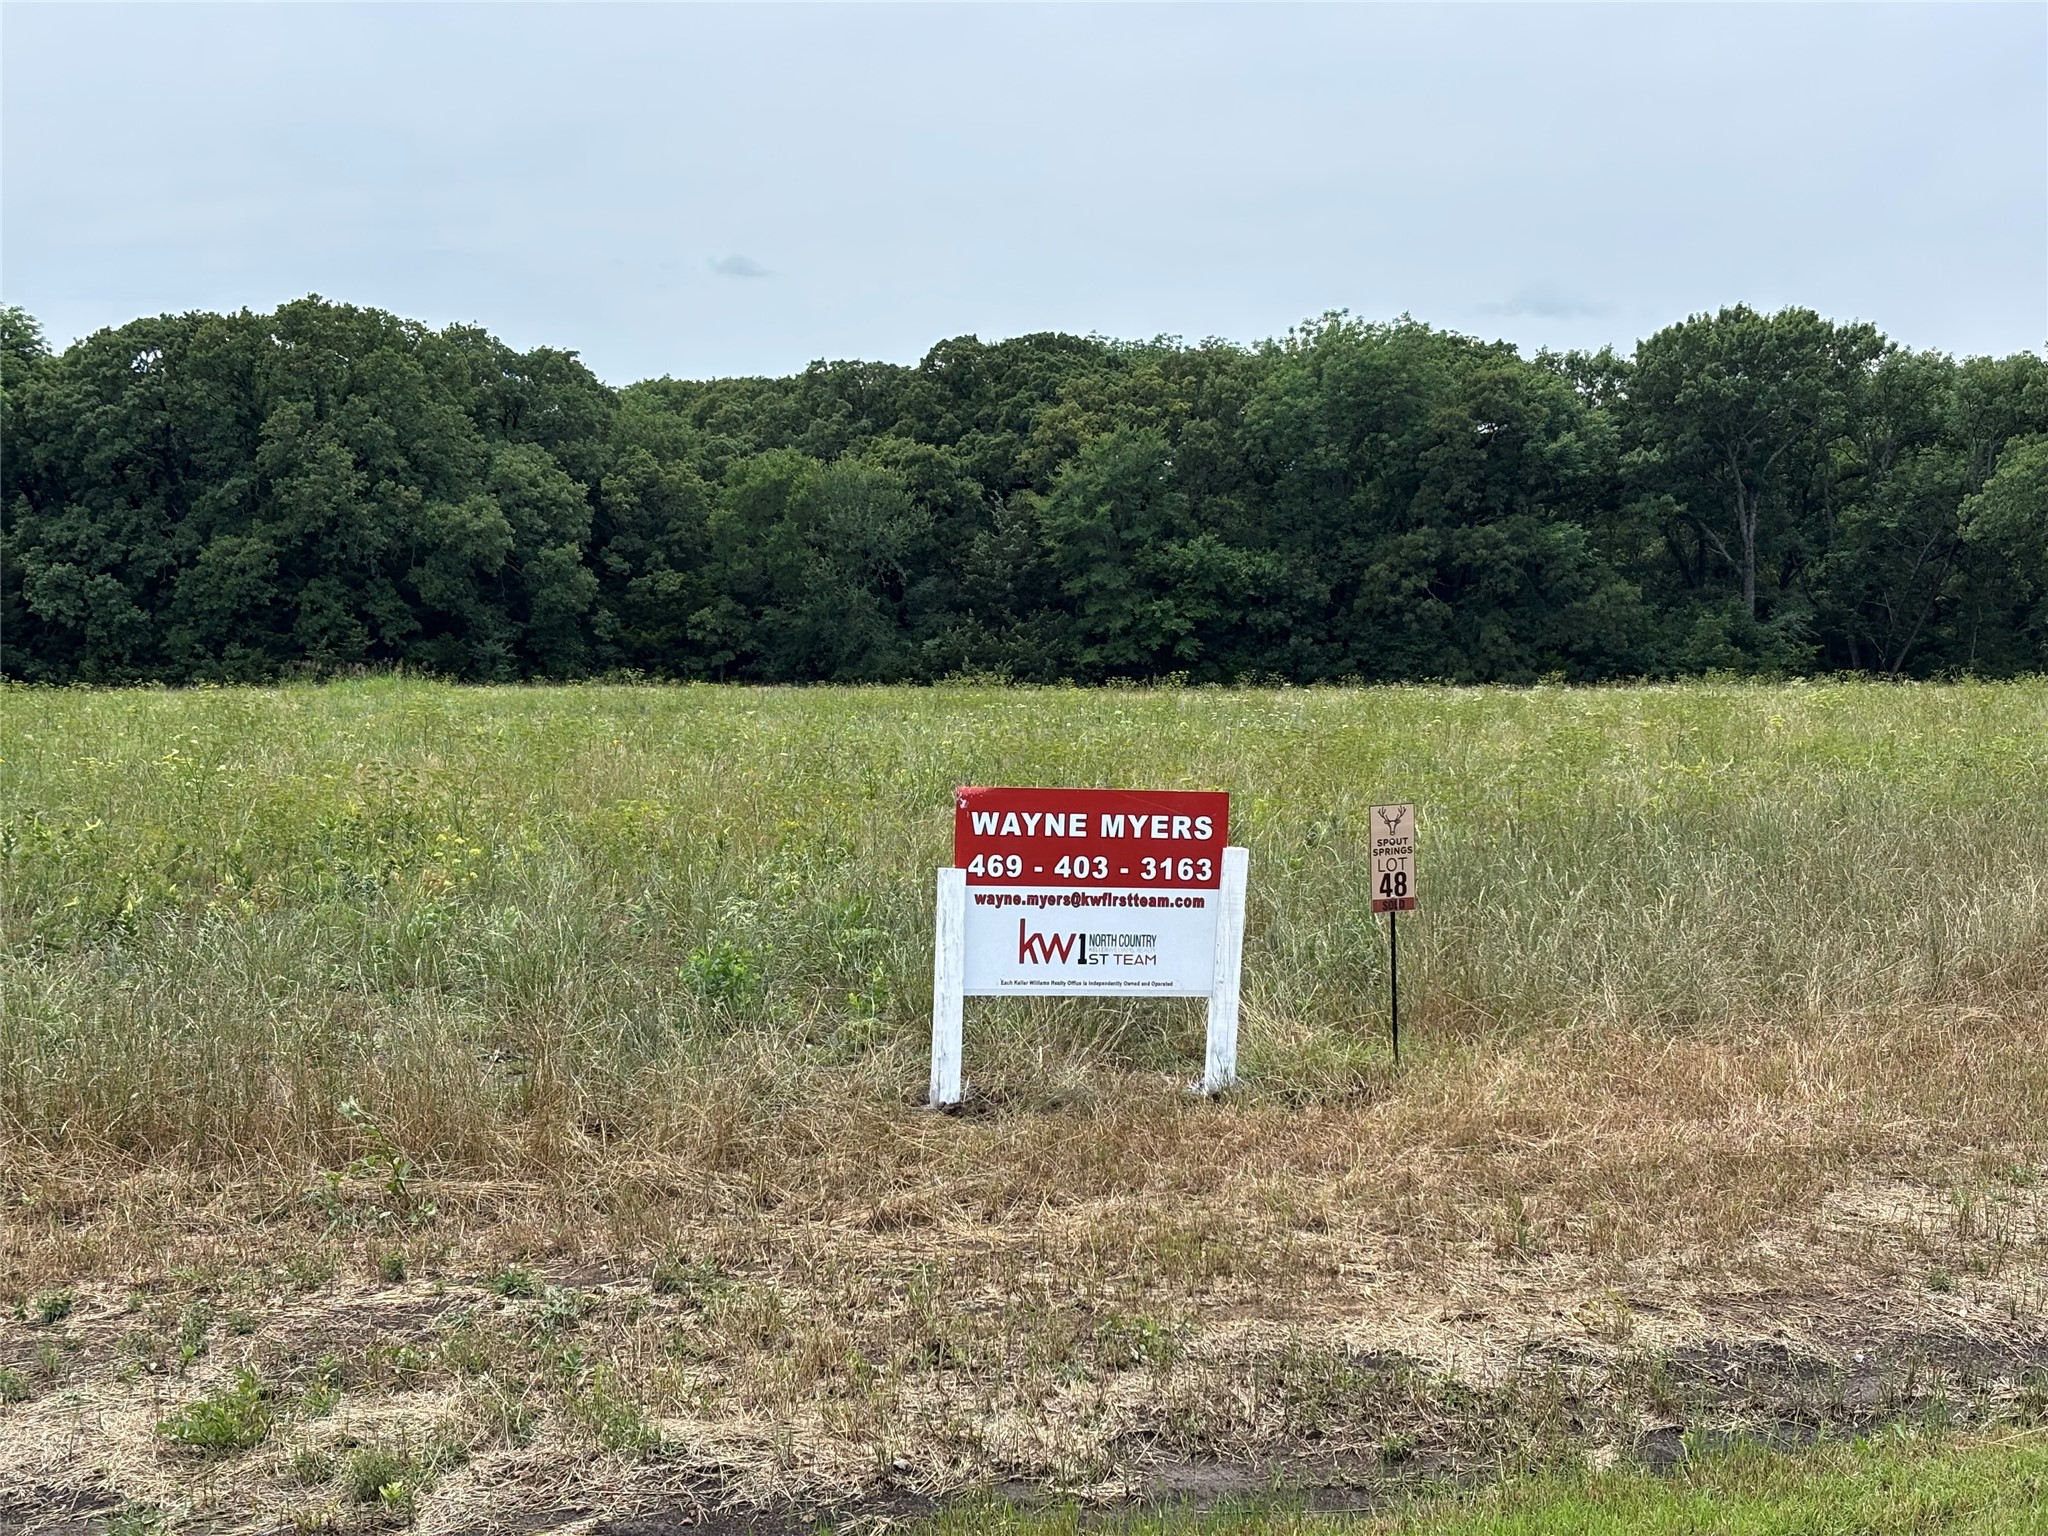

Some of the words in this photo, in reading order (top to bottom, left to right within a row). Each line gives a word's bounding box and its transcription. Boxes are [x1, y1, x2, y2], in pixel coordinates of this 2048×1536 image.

[971, 811, 1088, 838] WAYNE
[1100, 814, 1213, 840] MYERS
[1377, 837, 1408, 847] SPOUT
[1373, 846, 1413, 857] SPRINGS
[967, 854, 1023, 878] 469
[1054, 855, 1109, 880] 403
[1140, 857, 1213, 882] 3163
[1378, 857, 1408, 872] LOT
[1379, 872, 1407, 898] 48
[974, 892, 1205, 910] wayne.myers@kwfirstteam.com
[1382, 898, 1405, 911] SOLD
[1089, 933, 1117, 947] NORTH
[1118, 934, 1157, 948] COUNTRY
[1113, 953, 1157, 966] TEAM
